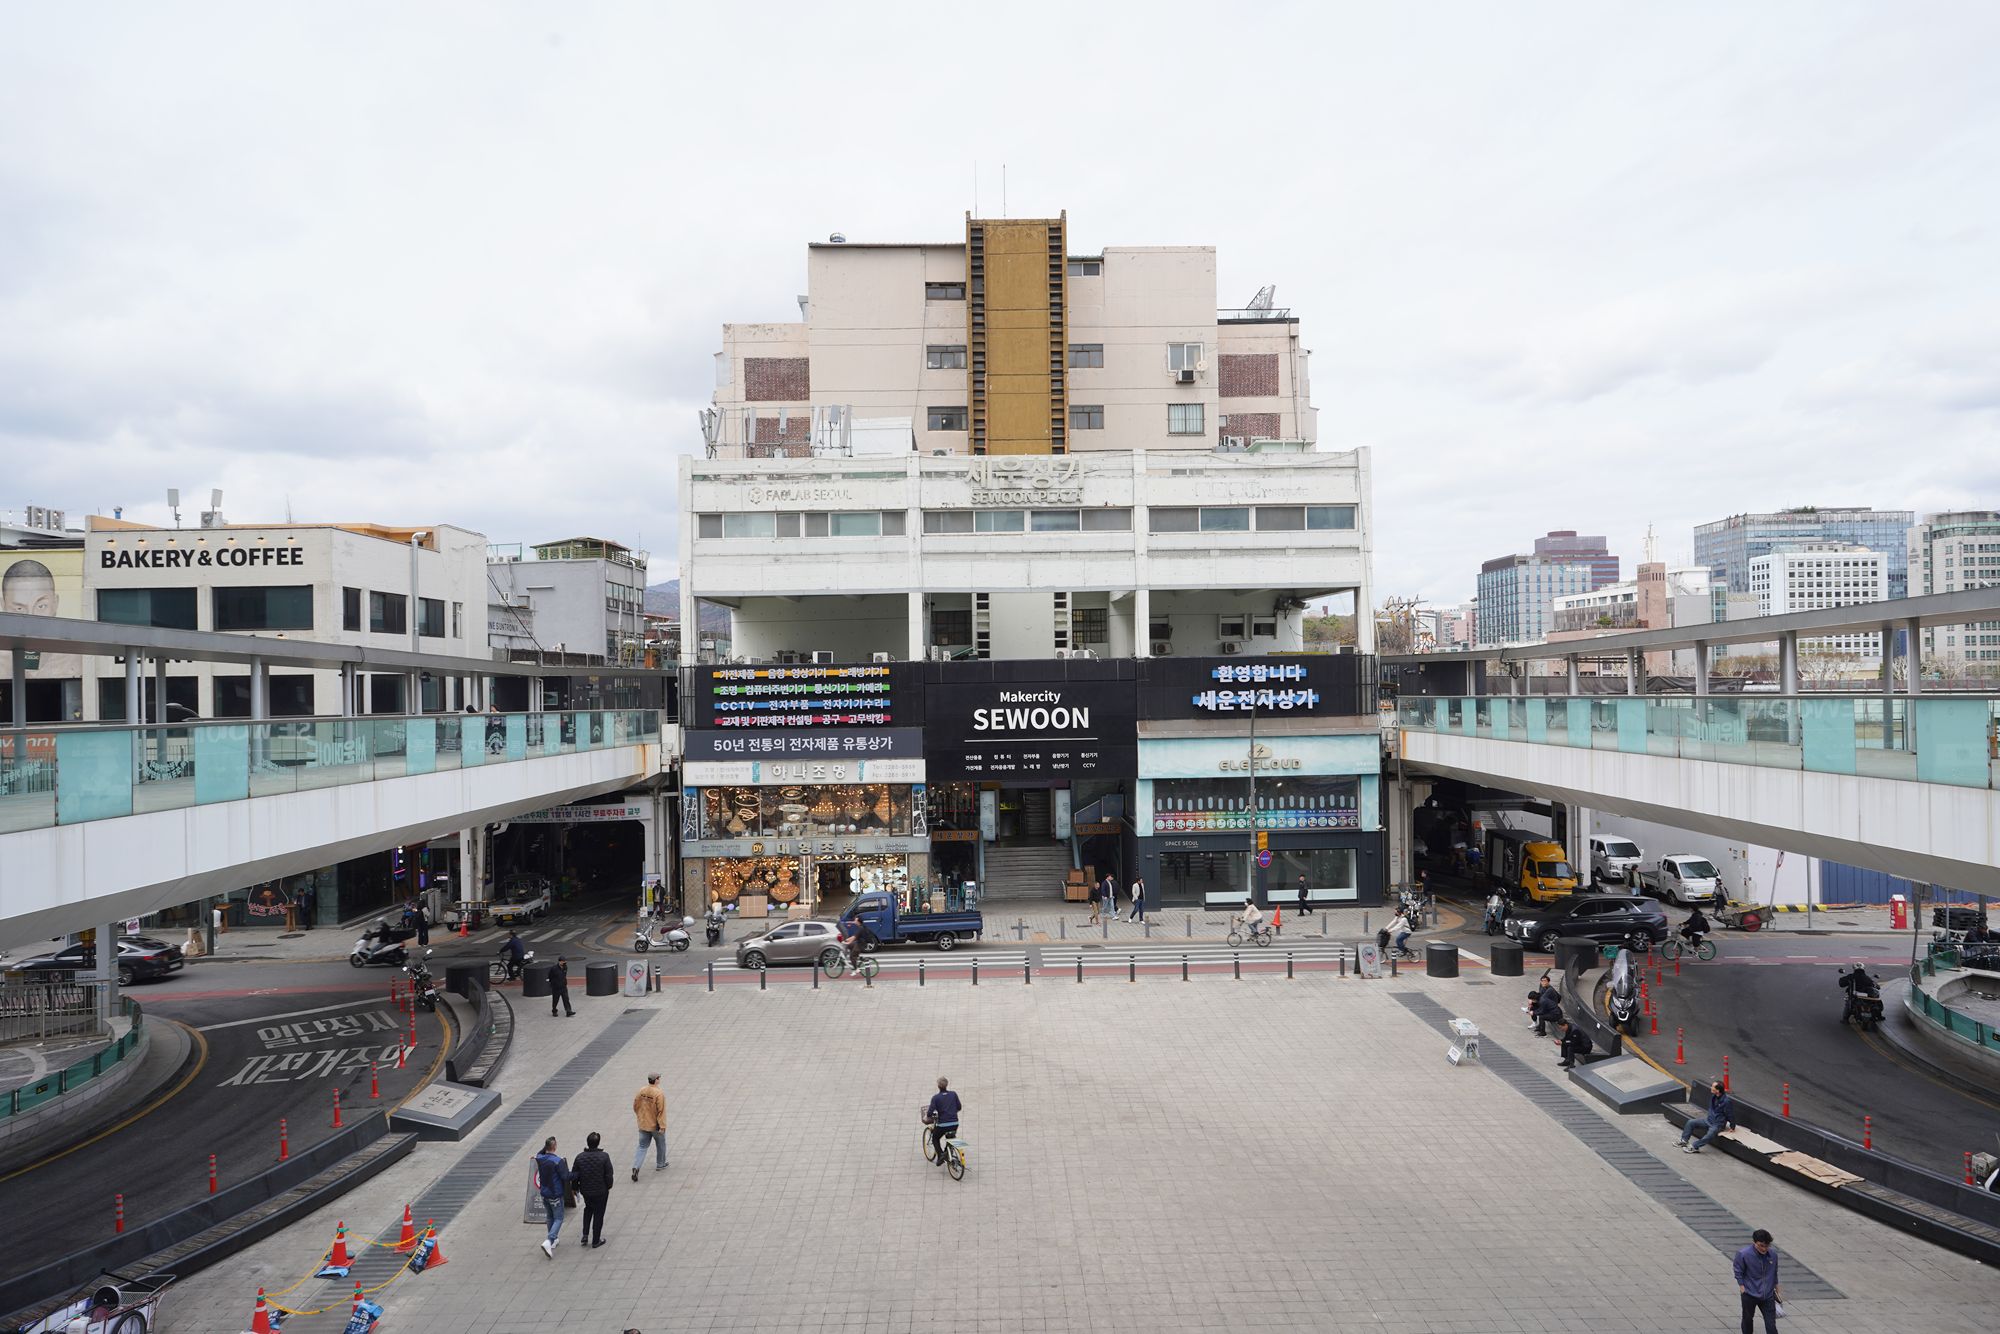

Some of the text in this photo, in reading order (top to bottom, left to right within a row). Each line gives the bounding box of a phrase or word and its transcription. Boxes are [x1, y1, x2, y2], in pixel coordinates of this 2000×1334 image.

[966, 456, 1085, 489] 세운상가
[971, 488, 1084, 504] SEWOON PLAZA
[101, 547, 304, 569] BAKERY & COFFEE
[720, 669, 755, 680] 가전제품
[839, 667, 883, 678] 노래방기기
[1217, 664, 1301, 683] 환영합니다
[720, 683, 883, 695] 조명 컴퓨터주변기기 통신기기 카메라
[1000, 690, 1061, 704] Makercity
[720, 699, 884, 711] CCTV 전자부품 전자기기수리
[1198, 689, 1314, 711] 세운전자상가
[741, 716, 750, 726] 및
[752, 715, 785, 726] 기판제작
[786, 715, 813, 726] 컨설팅
[822, 714, 841, 725] 공구
[848, 713, 884, 724] 고무박킹
[973, 707, 1089, 731] SEWOON
[714, 736, 893, 752] 50년 전통의 전자제품 유통상가
[771, 764, 847, 779] 하나조명
[593, 808, 625, 817] 무료주차권
[257, 1010, 399, 1049] 일단정지
[216, 1042, 418, 1087] 자전거주의
